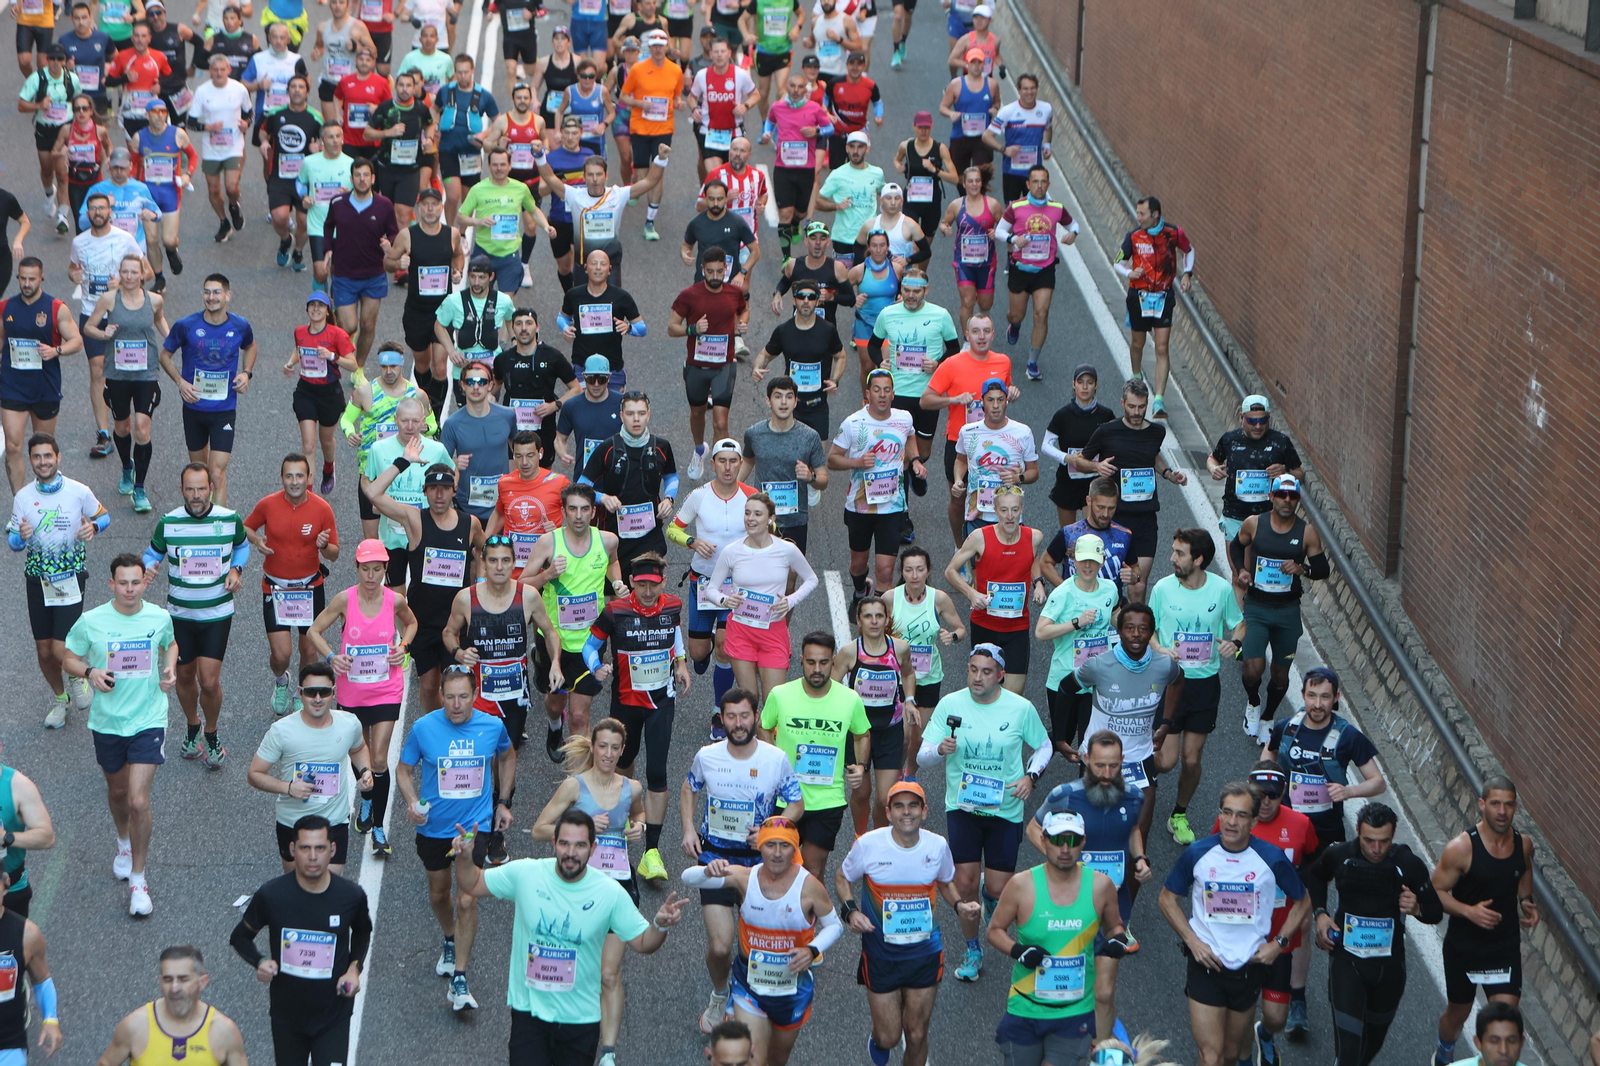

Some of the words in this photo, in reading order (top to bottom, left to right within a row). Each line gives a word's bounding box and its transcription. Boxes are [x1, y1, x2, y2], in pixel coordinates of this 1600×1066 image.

[708, 90, 734, 102] Ziggo
[876, 470, 896, 478] ZURICH
[50, 572, 72, 582] ZURICH
[572, 596, 592, 604] ZURICH
[749, 593, 770, 602] ZURICH
[644, 654, 666, 662] ZURICH
[494, 666, 517, 674] ZURICH
[449, 740, 474, 748] ATH
[964, 762, 1002, 771] SEVILLA'24
[976, 778, 999, 788] ZURICH
[972, 791, 987, 799] 6438
[723, 802, 749, 810] ZURICH
[602, 840, 623, 848] ZURICH
[900, 902, 925, 910] ZURICH
[900, 917, 916, 925] 6097
[1048, 919, 1083, 928] EALING
[1361, 919, 1388, 928] ZURICH
[299, 949, 316, 957] 7338
[542, 950, 570, 959] ZURICH
[1054, 959, 1081, 967] ZURICH
